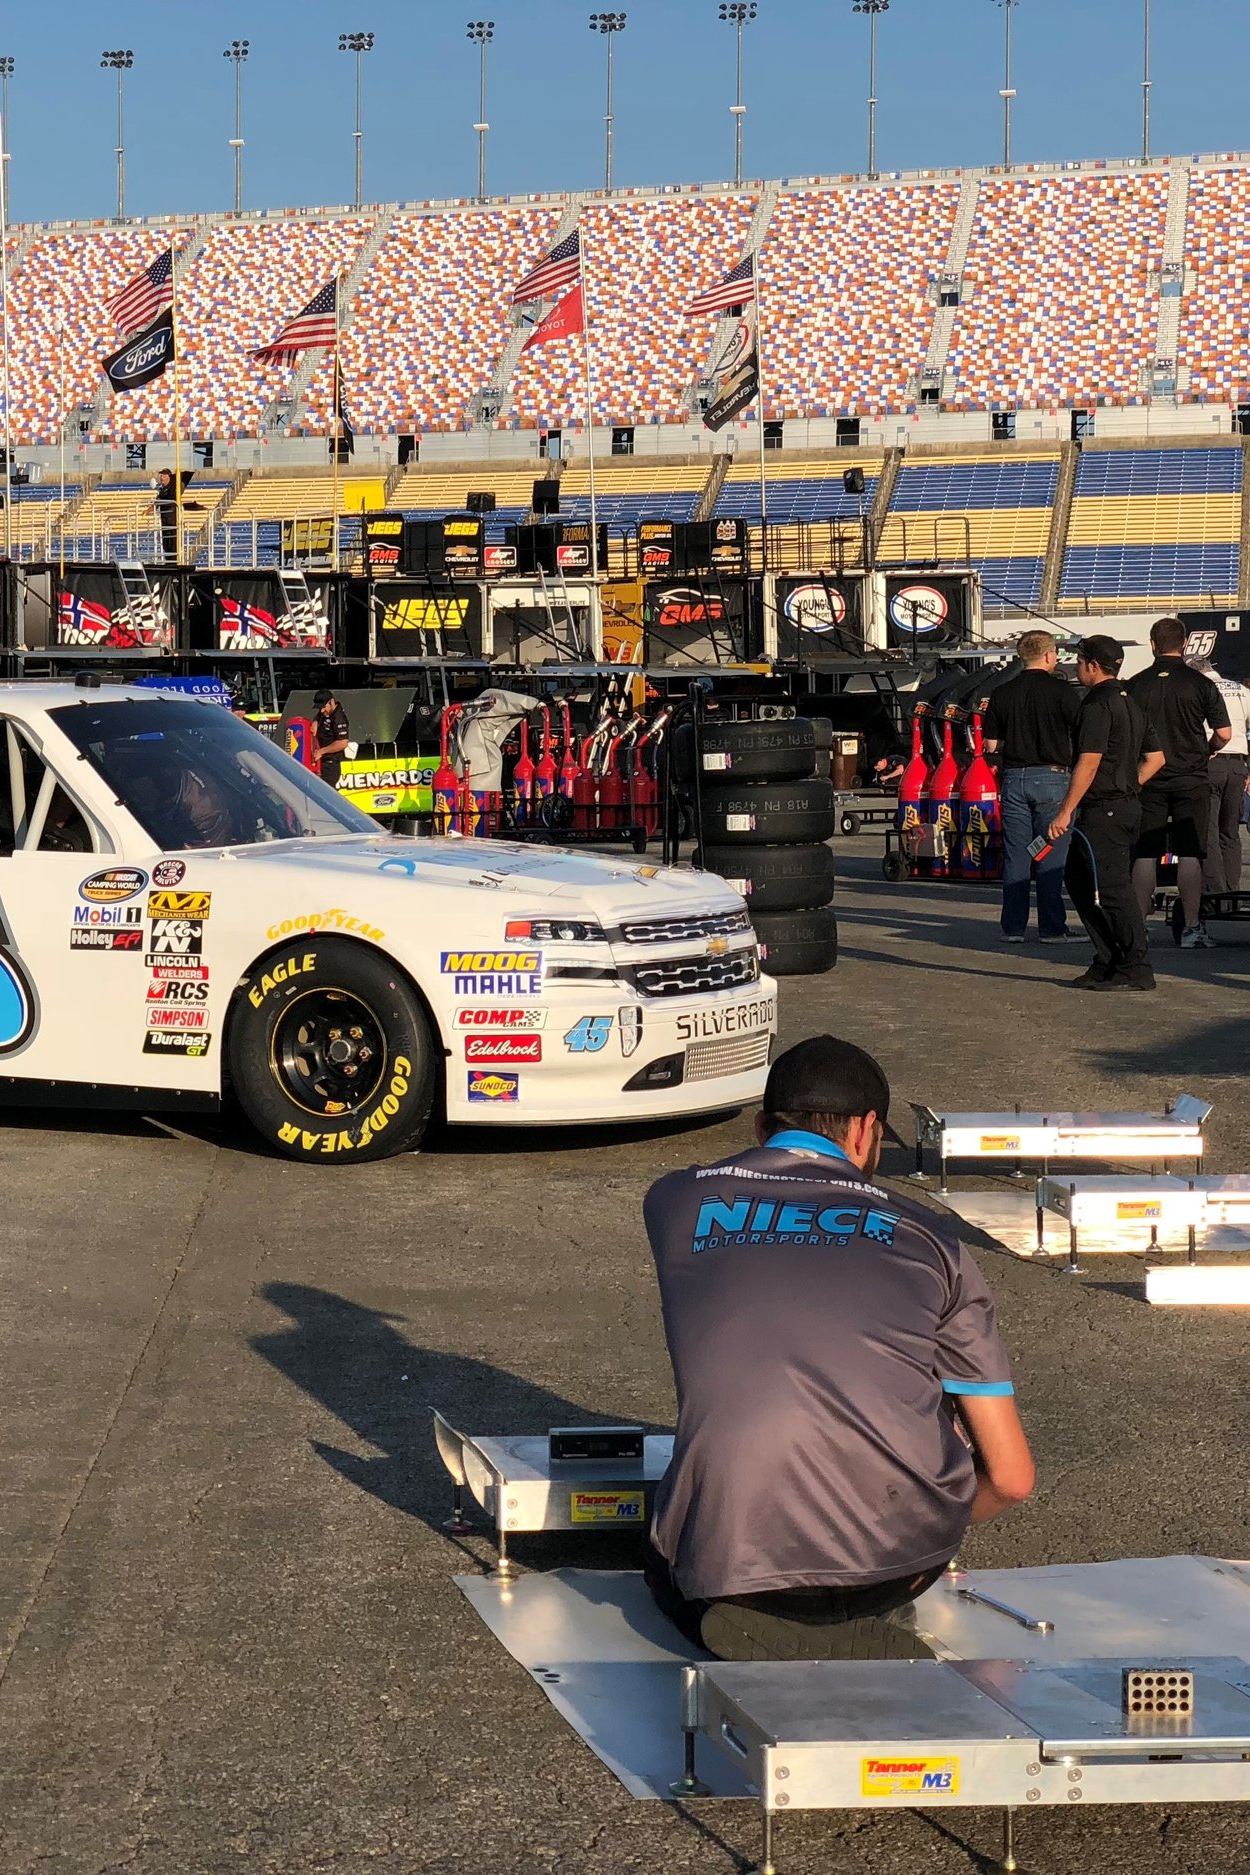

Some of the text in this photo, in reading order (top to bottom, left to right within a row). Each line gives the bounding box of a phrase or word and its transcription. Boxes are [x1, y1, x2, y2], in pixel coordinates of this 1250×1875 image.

[124, 336, 167, 373] Ford
[367, 521, 403, 535] JEGS
[443, 521, 480, 536] JEGS
[369, 550, 400, 560] GMS
[643, 552, 670, 562] GMS
[381, 598, 470, 630] JEGS
[902, 599, 937, 613] YONG'S
[659, 602, 724, 627] GMS
[57, 623, 111, 646] Thor
[1185, 632, 1217, 658] 55
[336, 768, 436, 790] MENARDS
[726, 801, 758, 813] 4798
[763, 800, 781, 812] PN
[158, 859, 183, 870] NASCAR
[87, 880, 141, 890] CAMPING WORLD
[116, 872, 140, 882] NASCAR
[73, 906, 123, 924] Mobil
[148, 908, 210, 919] MECHANIX WEAR
[71, 929, 115, 950] Holley
[146, 955, 198, 968] LINCOLN
[443, 952, 540, 972] MOOG
[157, 968, 204, 980] WELDERS
[247, 952, 318, 1010] EAGLE
[164, 980, 210, 1001] RCS
[454, 974, 542, 995] MAHLE
[183, 999, 207, 1007] Spring
[149, 1009, 205, 1027] SIMPSON
[458, 1009, 525, 1025] COMP
[676, 998, 774, 1041] SILVERADO
[149, 1031, 209, 1047] Duralast
[564, 1016, 614, 1053] 45
[185, 1045, 206, 1057] GT
[466, 1039, 540, 1057] Edelbrock
[471, 1082, 515, 1091] SUNOCO
[693, 1195, 901, 1248] NIECE
[692, 1233, 850, 1255] MOTORSPORTS
[575, 1494, 622, 1505] Tanner
[617, 1503, 640, 1516] M3
[867, 1760, 927, 1773] Tanner
[921, 1772, 953, 1789] M3
